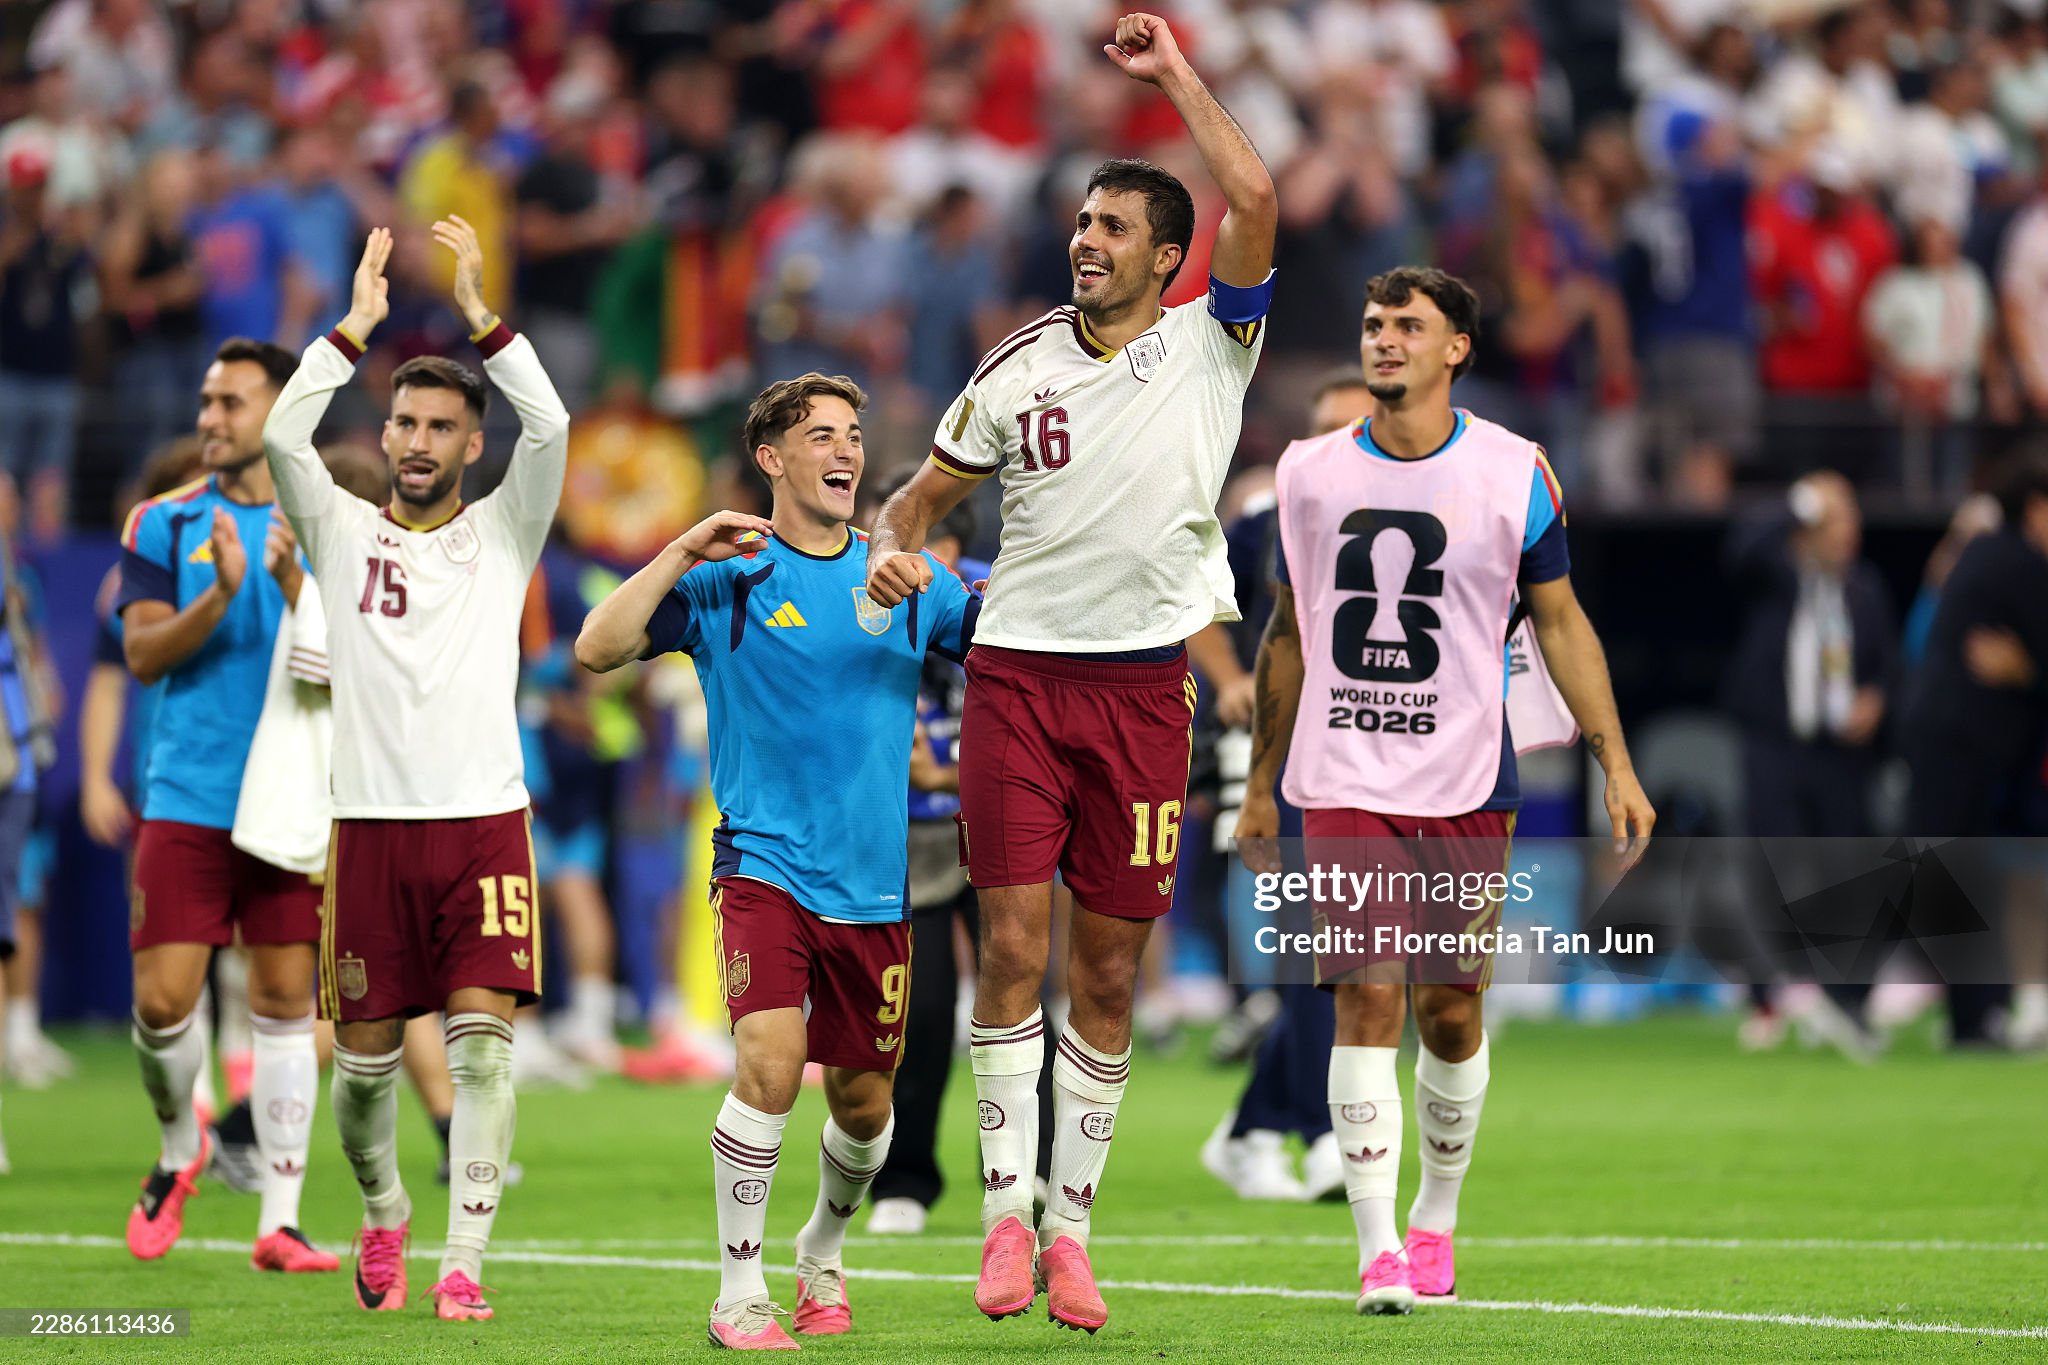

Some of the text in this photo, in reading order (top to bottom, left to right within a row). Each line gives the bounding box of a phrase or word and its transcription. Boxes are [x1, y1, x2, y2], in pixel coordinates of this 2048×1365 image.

[1015, 406, 1072, 472] 16
[359, 557, 408, 618] 15
[1362, 647, 1412, 669] FIFA
[1328, 706, 1437, 735] 2026
[1330, 687, 1438, 707] WORLD CUP
[1129, 799, 1181, 867] 16
[477, 874, 530, 938] 15
[876, 964, 906, 1025] 9
